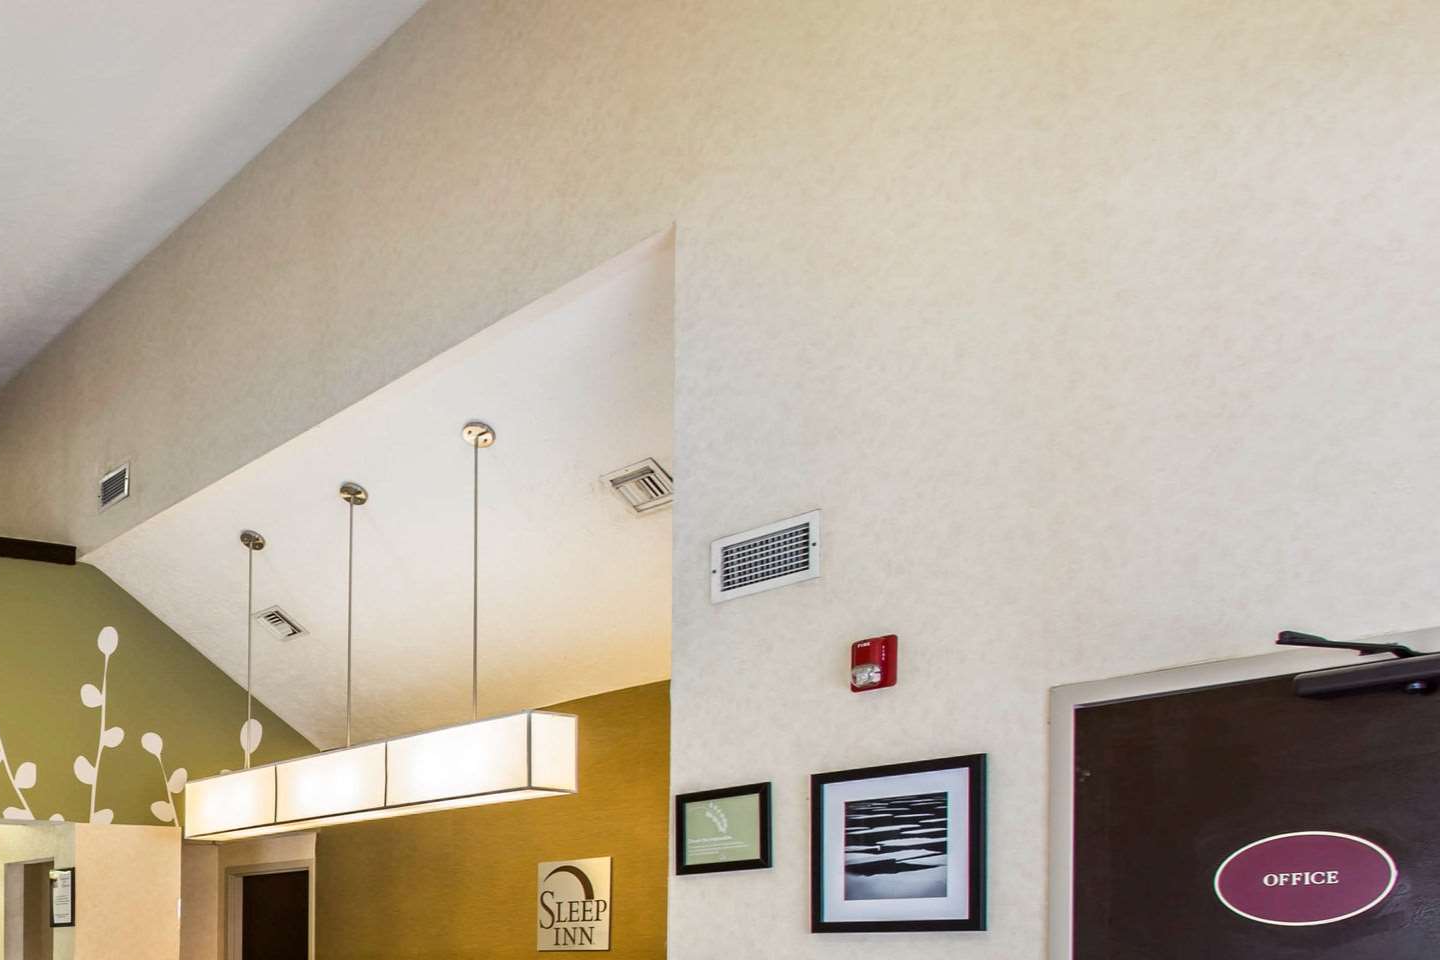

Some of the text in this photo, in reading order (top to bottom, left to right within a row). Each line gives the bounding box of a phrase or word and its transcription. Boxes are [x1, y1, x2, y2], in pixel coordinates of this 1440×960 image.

[1263, 870, 1340, 887] OFFICE
[539, 890, 607, 929] SLEEP
[553, 926, 596, 946] INN
